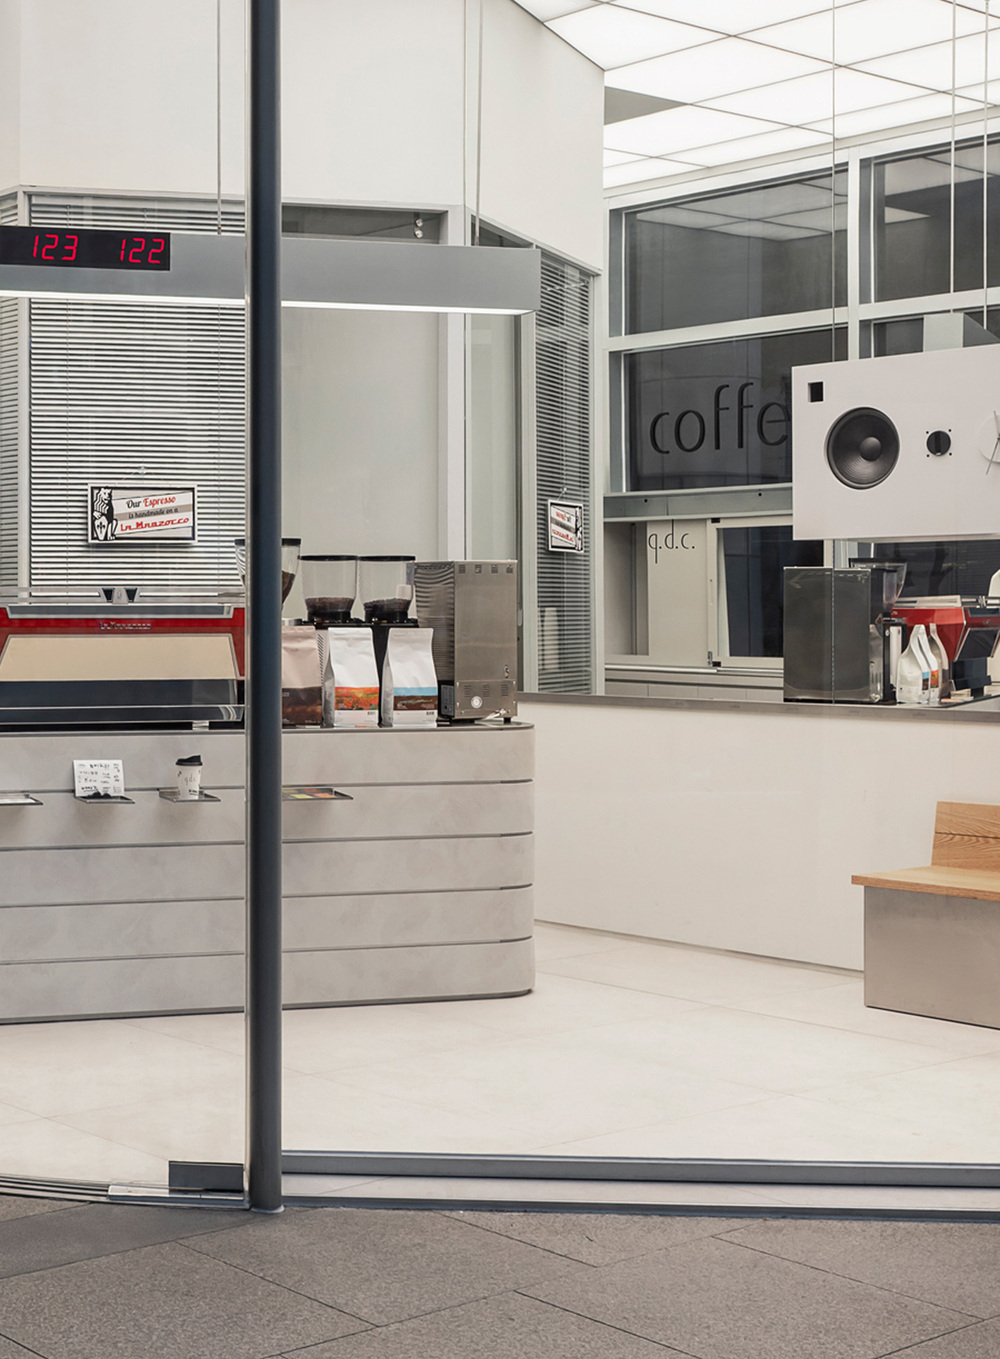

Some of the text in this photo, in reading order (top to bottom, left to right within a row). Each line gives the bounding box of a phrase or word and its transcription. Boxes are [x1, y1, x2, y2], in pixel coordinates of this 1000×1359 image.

[32, 234, 79, 261] 123
[119, 237, 166, 264] 122
[126, 496, 177, 509] Our Espresso
[134, 508, 165, 518] handmade
[648, 519, 695, 564] q.d.c.
